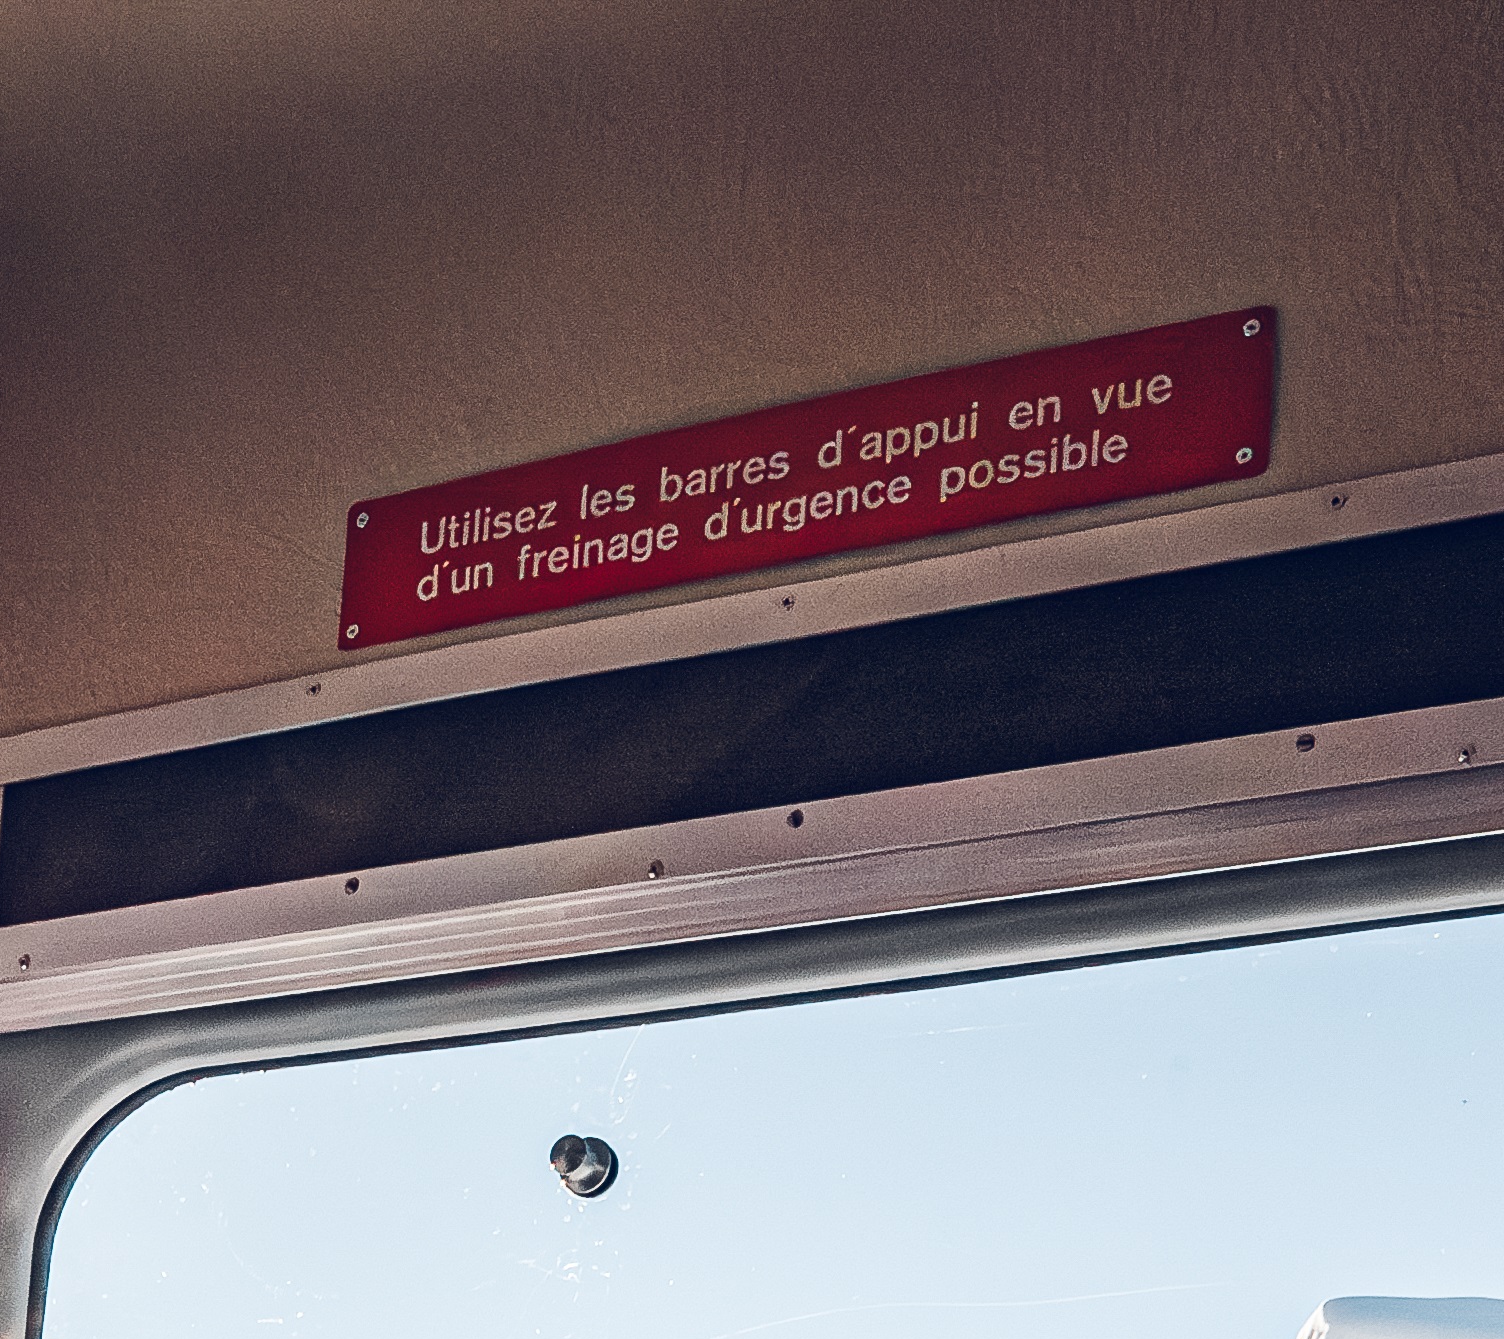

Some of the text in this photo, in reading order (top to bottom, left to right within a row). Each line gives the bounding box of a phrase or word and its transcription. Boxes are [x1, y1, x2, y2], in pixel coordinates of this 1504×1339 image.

[416, 430, 1130, 602] d'un freinage d'urgence possible
[420, 370, 1174, 557] Utilisez les barres d'appui en vue
